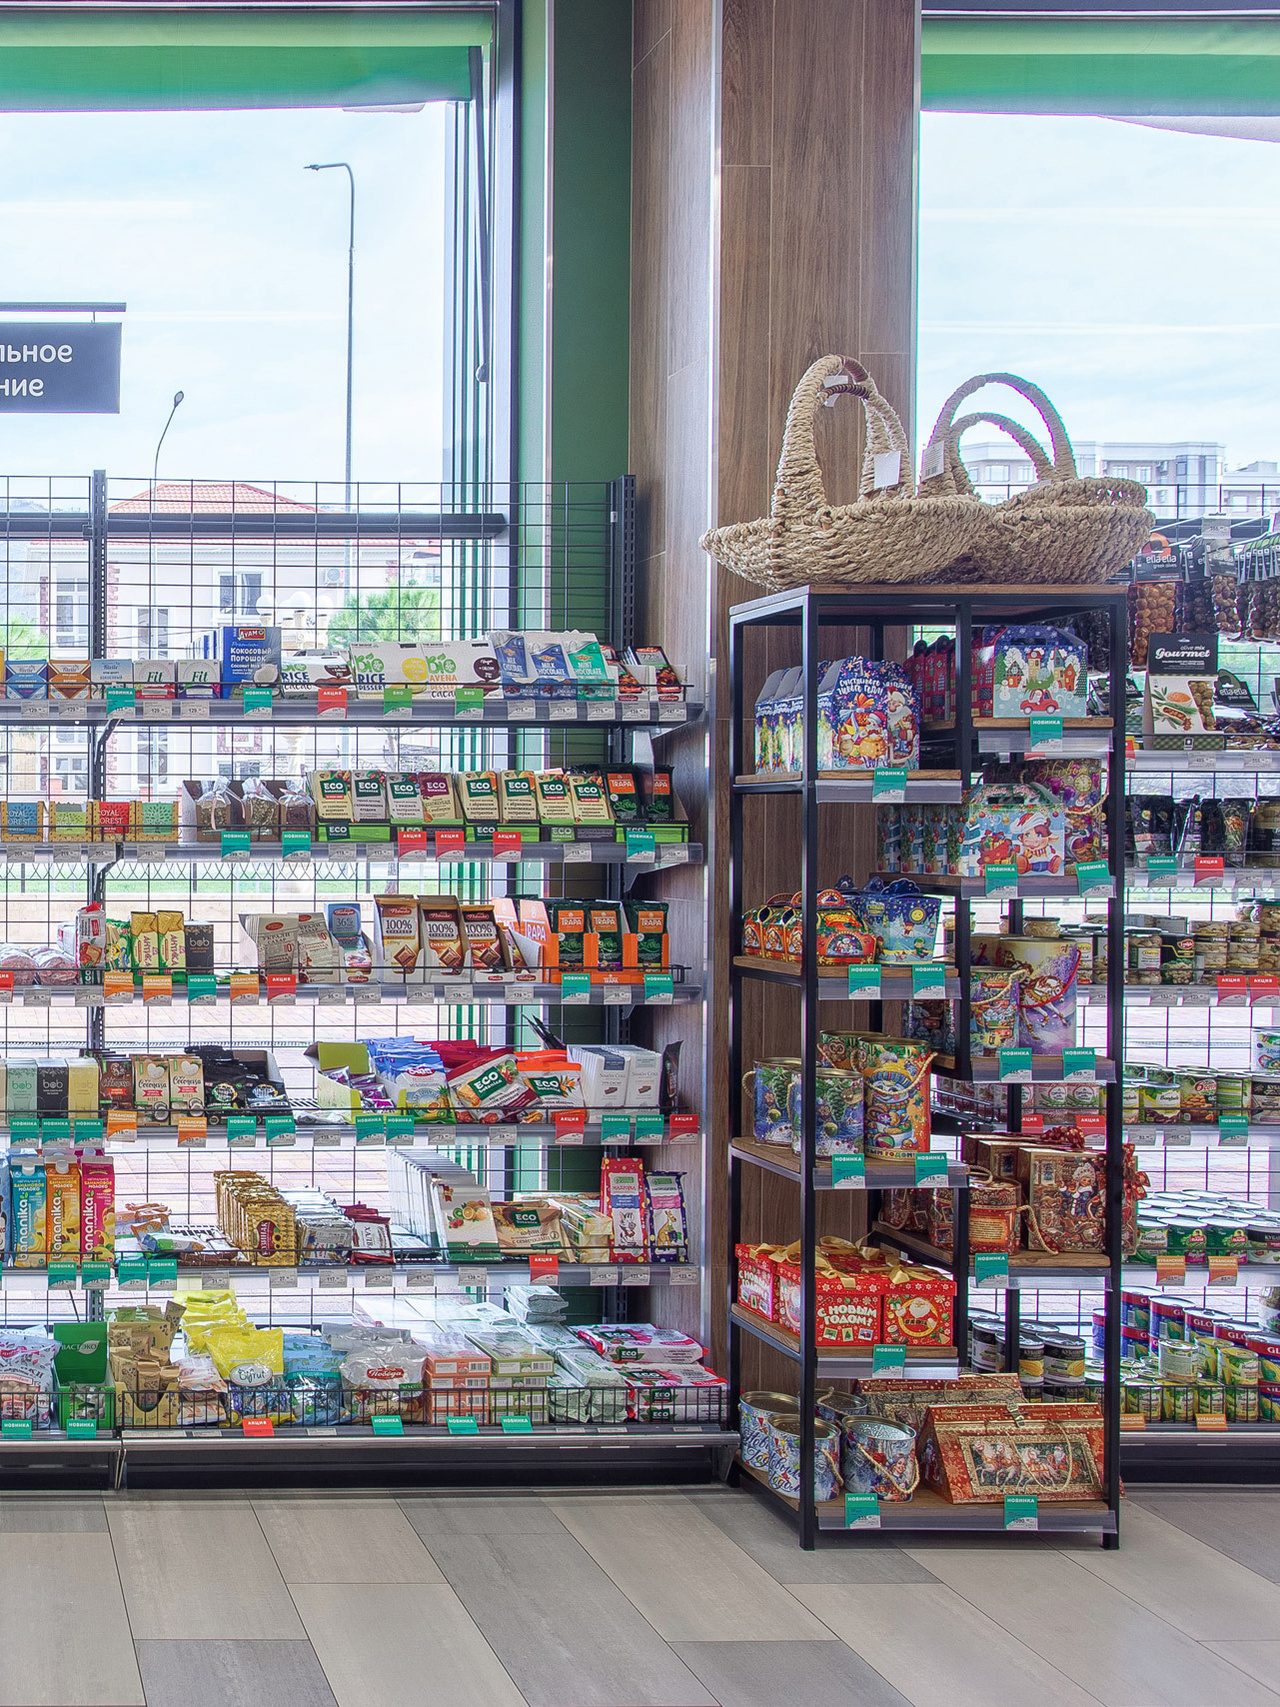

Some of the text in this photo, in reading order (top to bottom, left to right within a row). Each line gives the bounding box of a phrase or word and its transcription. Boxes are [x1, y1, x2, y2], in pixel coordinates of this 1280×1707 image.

[1155, 648, 1210, 659] Gourmet
[148, 671, 163, 682] Fit
[192, 671, 208, 682] Fit
[282, 672, 309, 680] RICE
[359, 674, 385, 683] RICE
[429, 674, 457, 682] AVENA
[386, 920, 412, 929] 100%
[429, 924, 454, 933] 100%
[466, 924, 491, 933] 100%
[190, 936, 210, 946] bob
[12, 1080, 32, 1089] bob
[43, 1079, 63, 1088] bob
[474, 1071, 499, 1091] ECO
[534, 1079, 559, 1088] ECO
[17, 1199, 28, 1260] bananika
[828, 1305, 877, 1318] НОВЫМ
